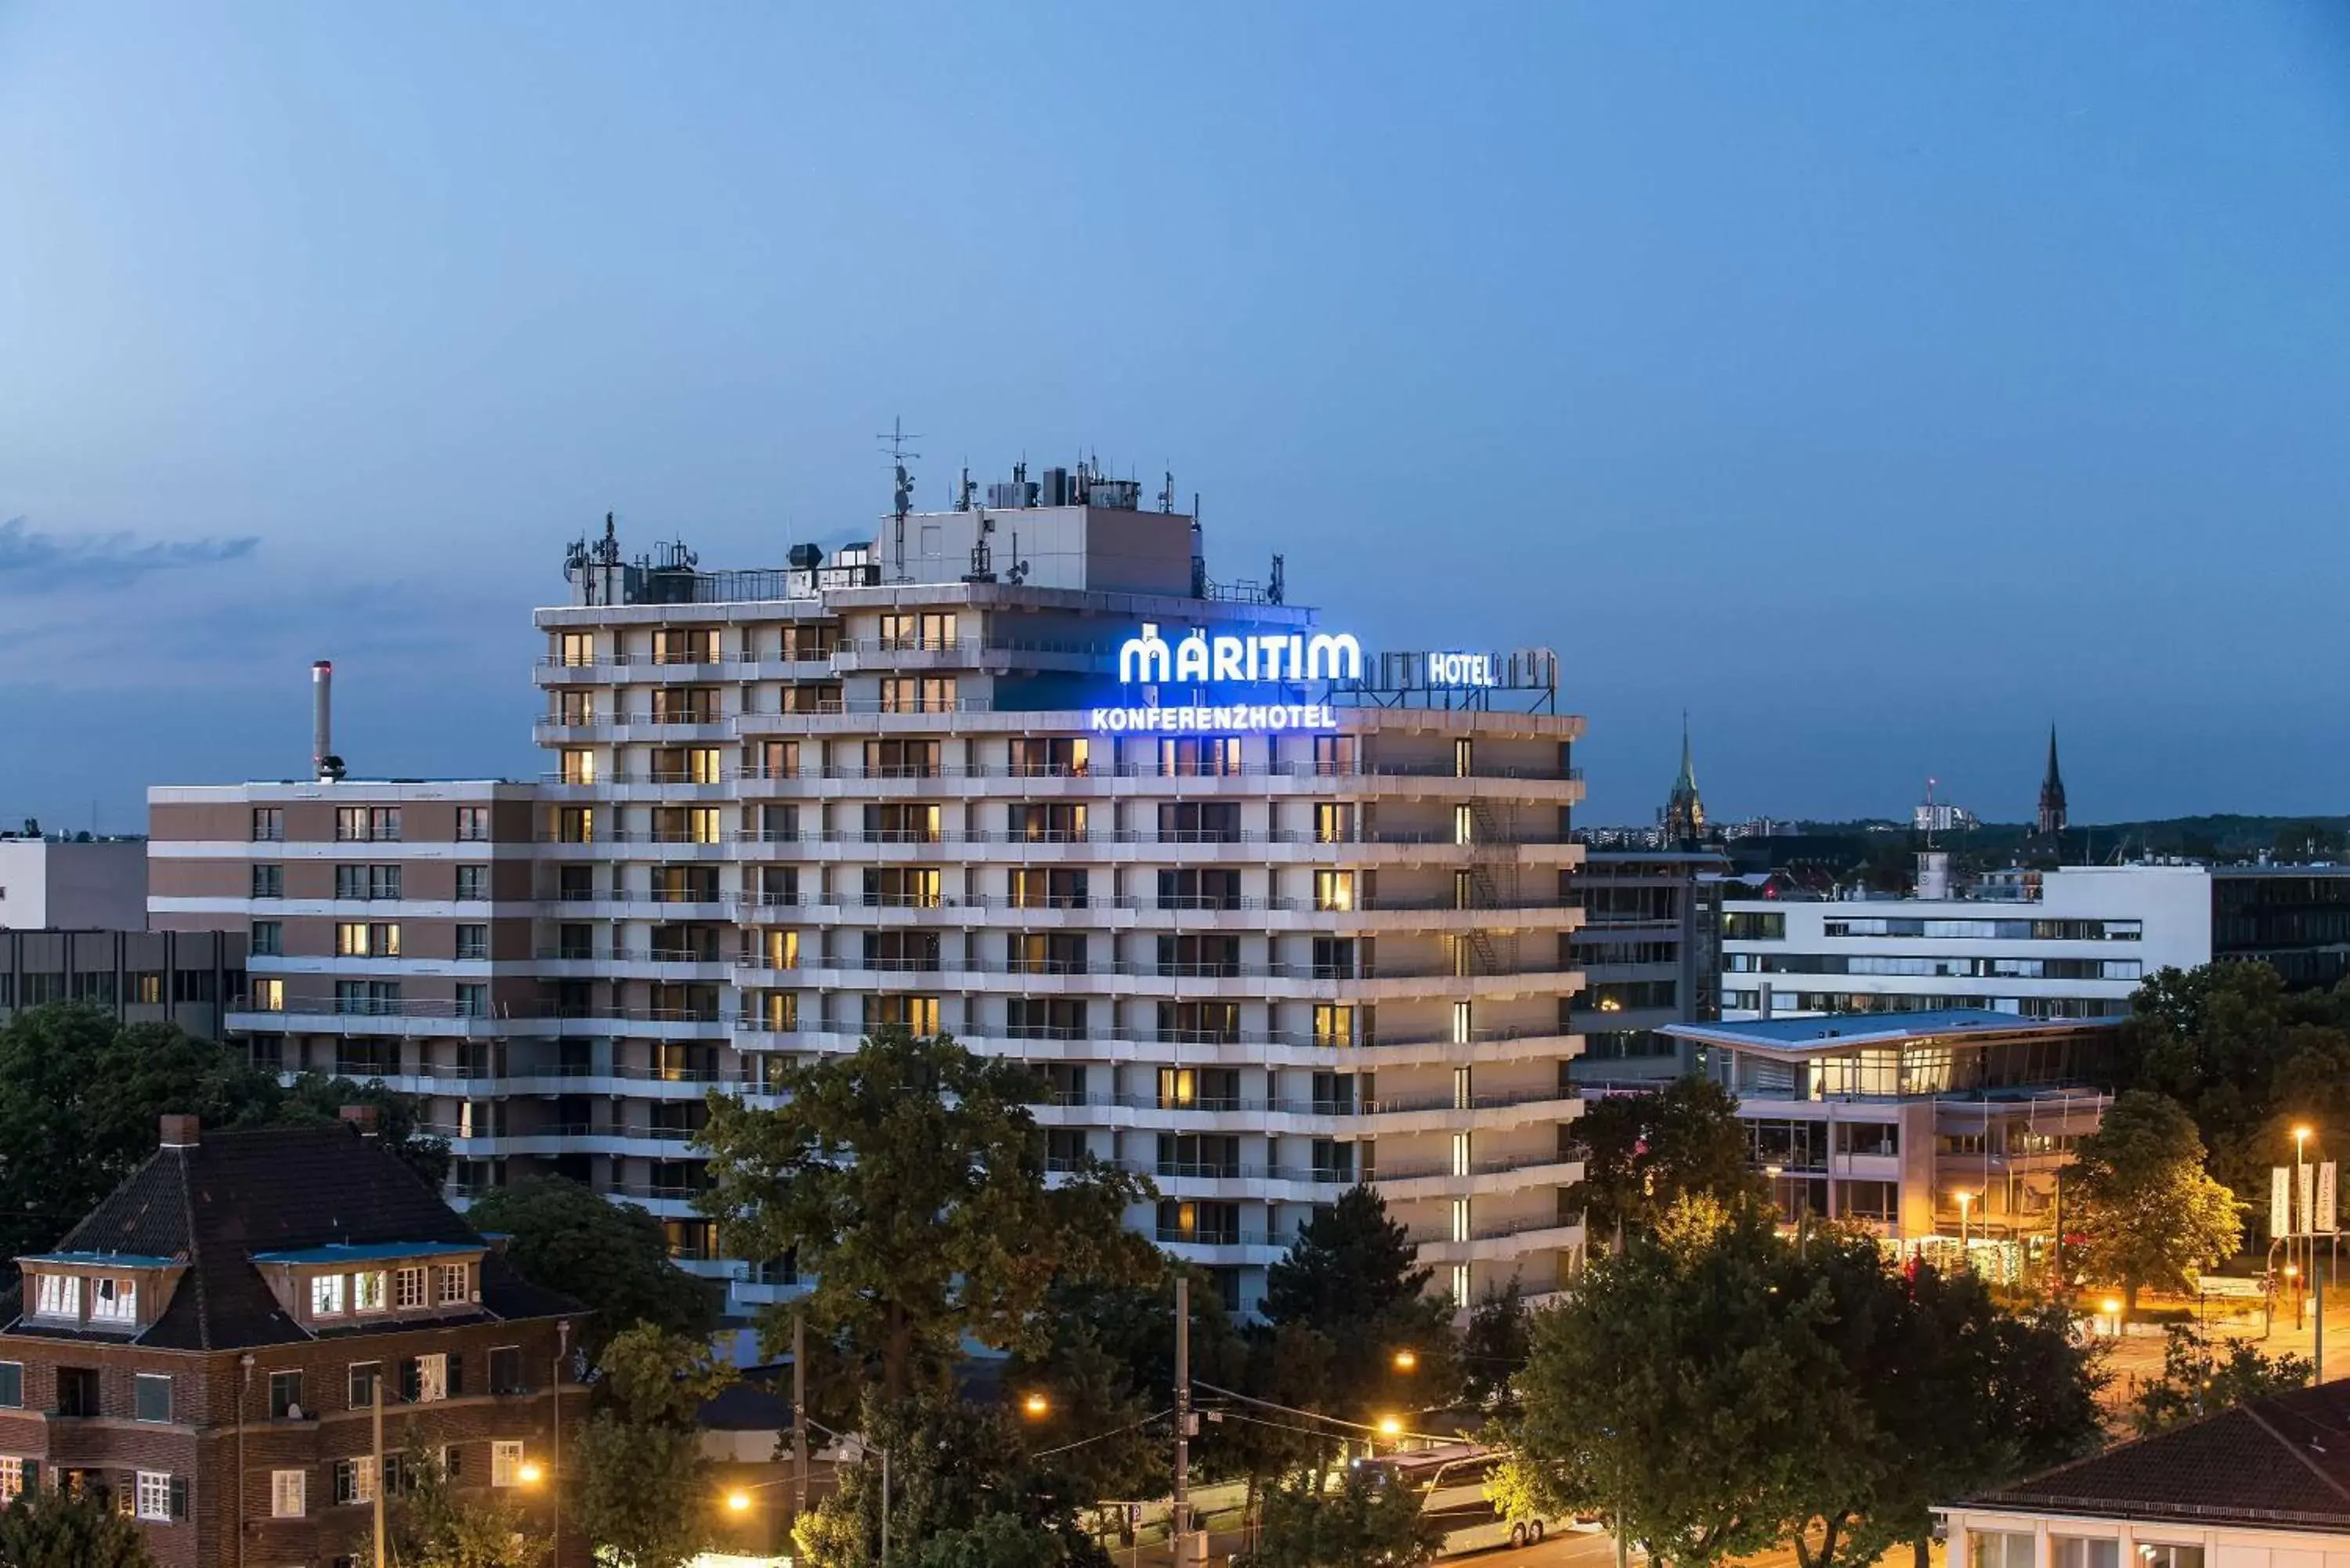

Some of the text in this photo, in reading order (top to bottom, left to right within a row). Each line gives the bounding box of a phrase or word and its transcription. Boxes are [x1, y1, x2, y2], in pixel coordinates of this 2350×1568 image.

[1119, 634, 1361, 683] MARITIM
[1430, 652, 1494, 686] HOTEL
[1092, 706, 1336, 731] KONFERENZHOTEL
